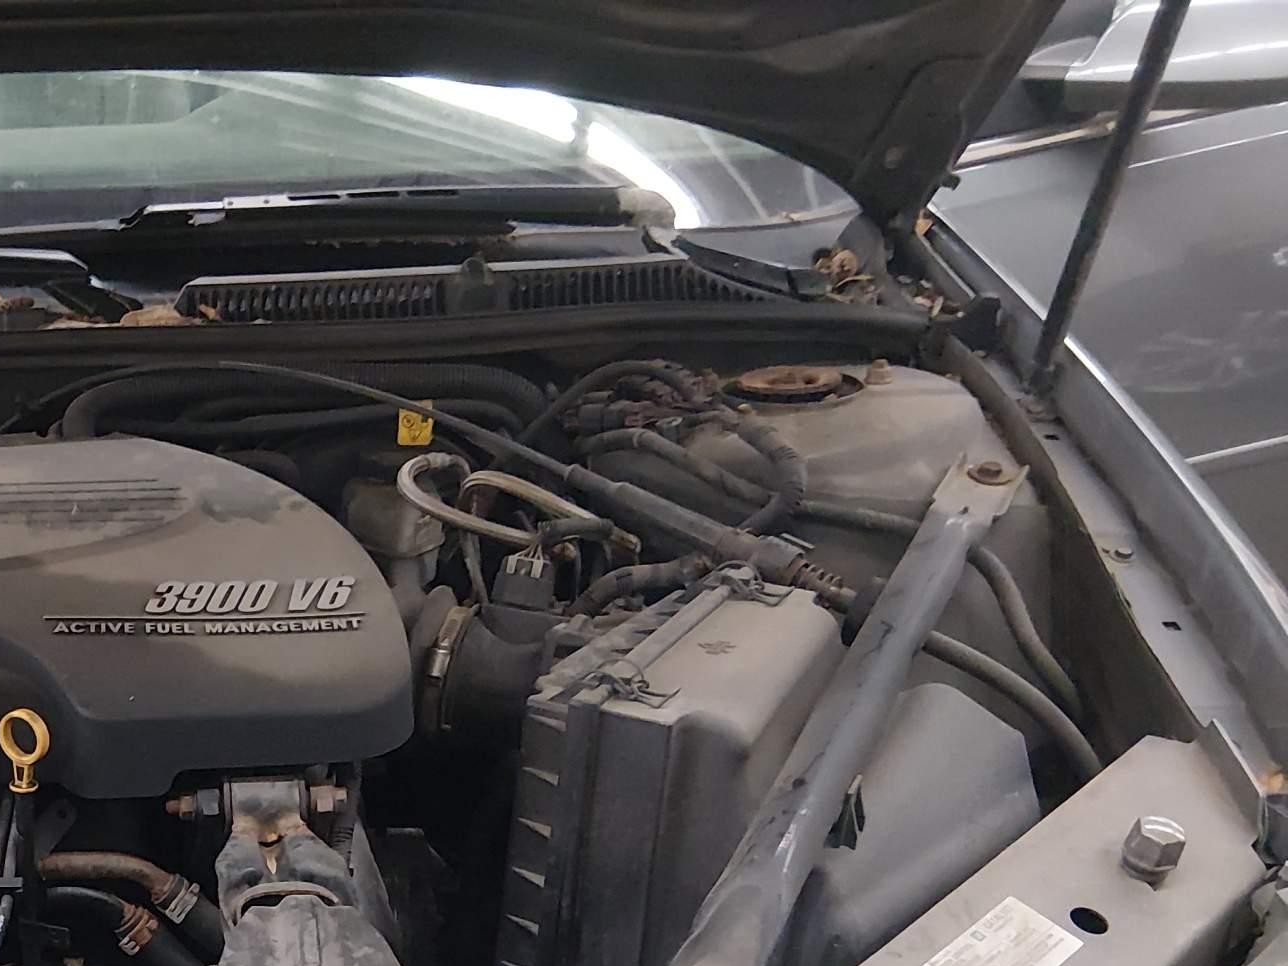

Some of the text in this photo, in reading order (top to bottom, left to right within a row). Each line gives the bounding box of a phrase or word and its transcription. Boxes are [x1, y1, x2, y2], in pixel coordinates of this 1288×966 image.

[144, 575, 357, 615] 3900 V6
[52, 617, 363, 635] ACTIVE FUEL MANAGEMENT
